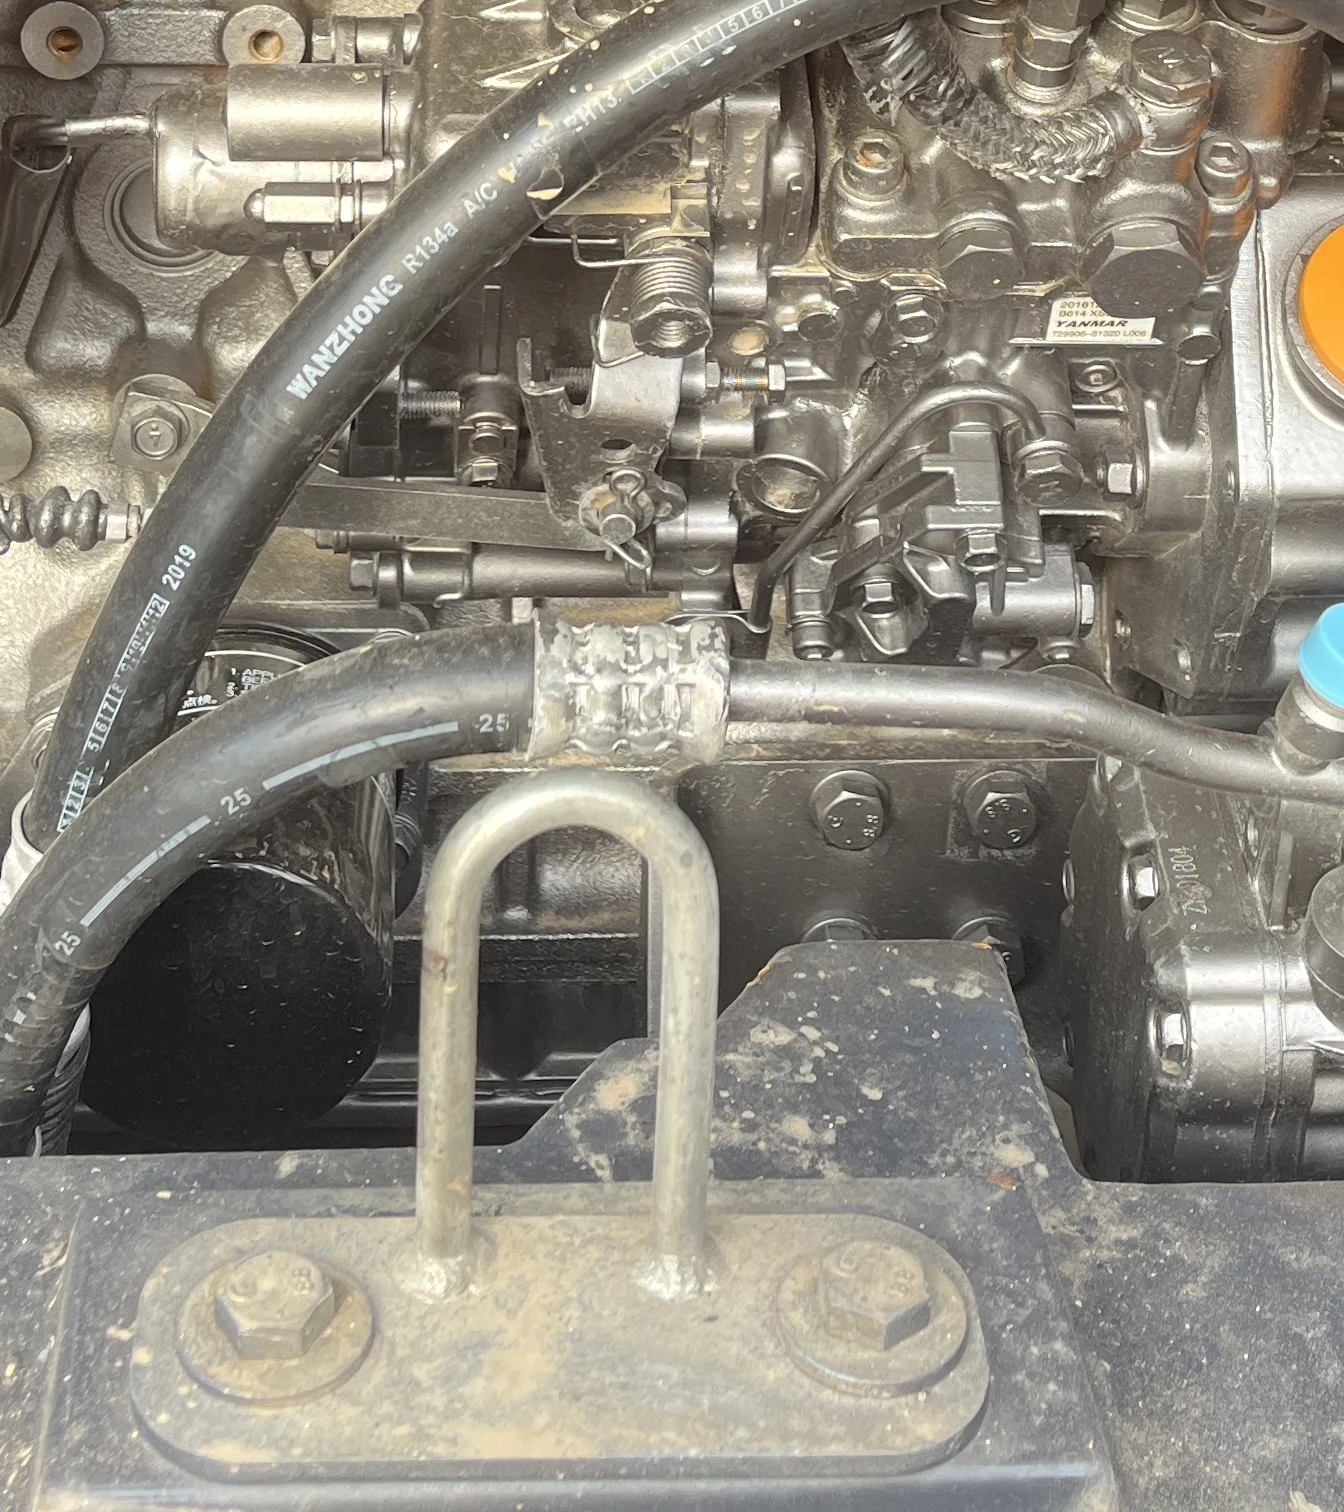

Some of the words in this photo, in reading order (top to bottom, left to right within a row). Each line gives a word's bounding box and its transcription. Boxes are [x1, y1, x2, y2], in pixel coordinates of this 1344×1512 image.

[286, 274, 403, 399] WANZHONG
[401, 221, 459, 274] R134a
[463, 182, 498, 219] A/C
[160, 543, 197, 591] 2019
[479, 713, 510, 733] 25
[220, 787, 253, 815] 25
